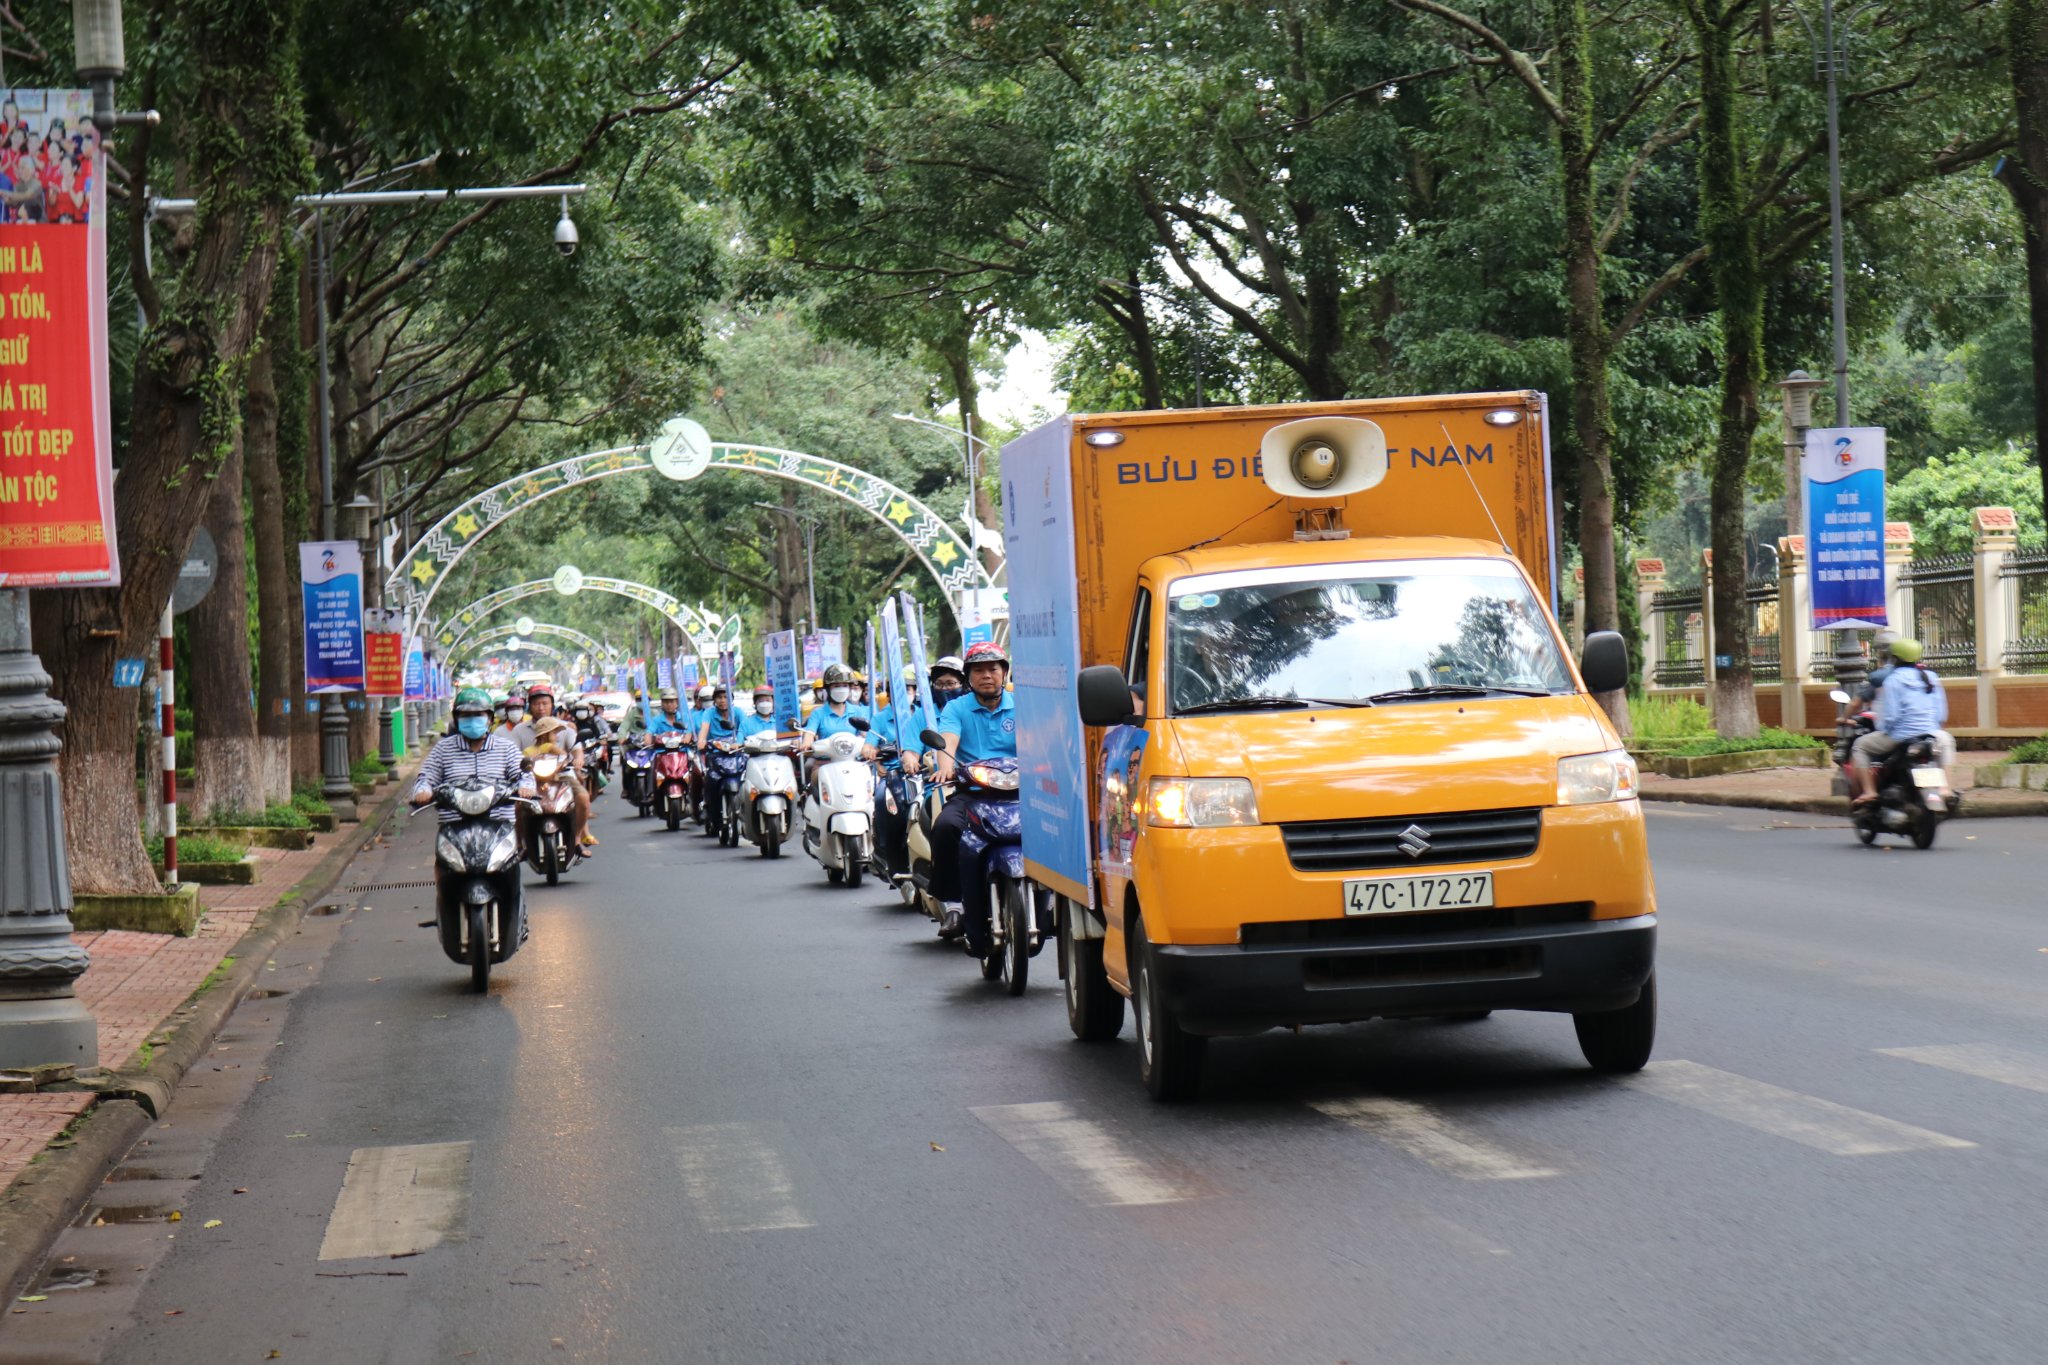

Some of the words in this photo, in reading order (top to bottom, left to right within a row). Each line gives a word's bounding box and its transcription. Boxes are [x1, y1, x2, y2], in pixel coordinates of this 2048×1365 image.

[21, 240, 43, 273] LÀ
[19, 383, 47, 416] TRỊ
[2, 420, 34, 457] TỐT
[38, 428, 74, 461] ĐẸP
[1117, 455, 1197, 484] BƯU
[1211, 447, 1266, 485] ĐIỆ
[1410, 443, 1493, 468] NAM
[24, 469, 58, 508] TỘC
[1350, 876, 1487, 911] 47C-172.27
